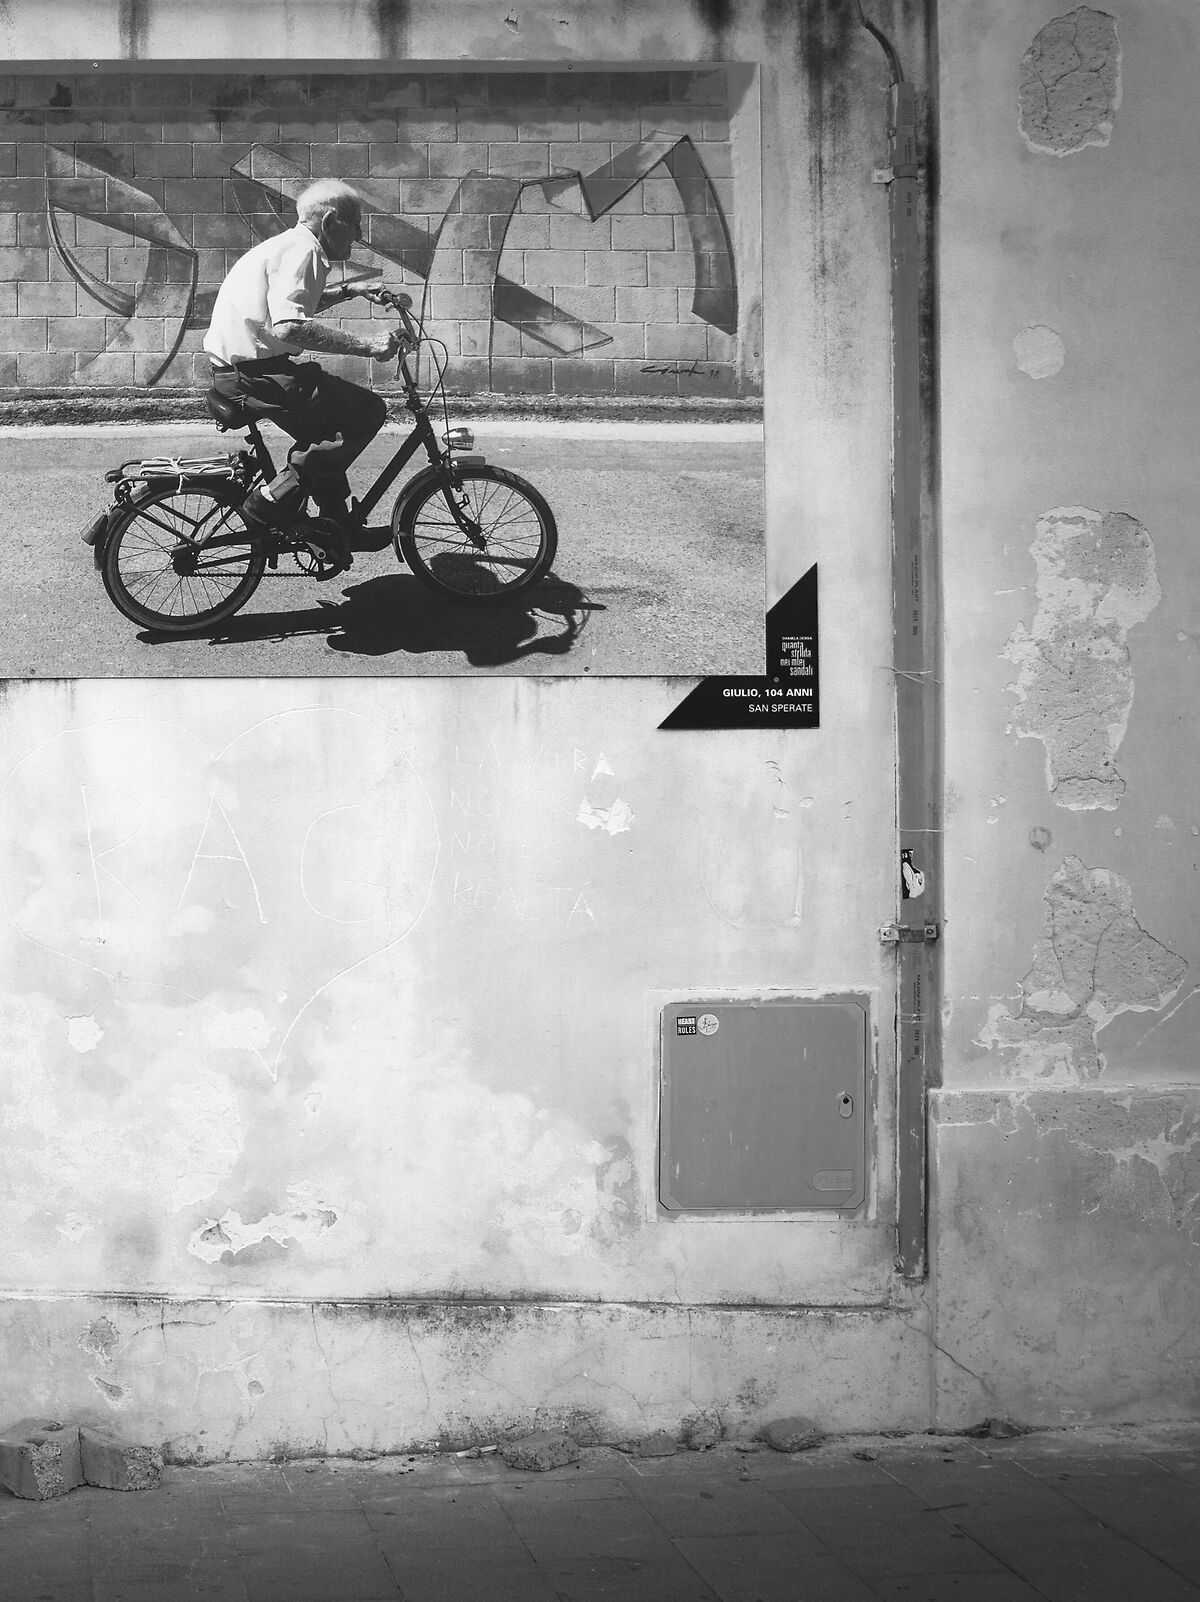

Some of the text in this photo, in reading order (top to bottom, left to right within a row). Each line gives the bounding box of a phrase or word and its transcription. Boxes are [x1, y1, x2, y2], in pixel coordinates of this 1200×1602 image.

[722, 688, 813, 698] GIULIO, 104 ANNI
[748, 703, 813, 713] SAN SPERATE
